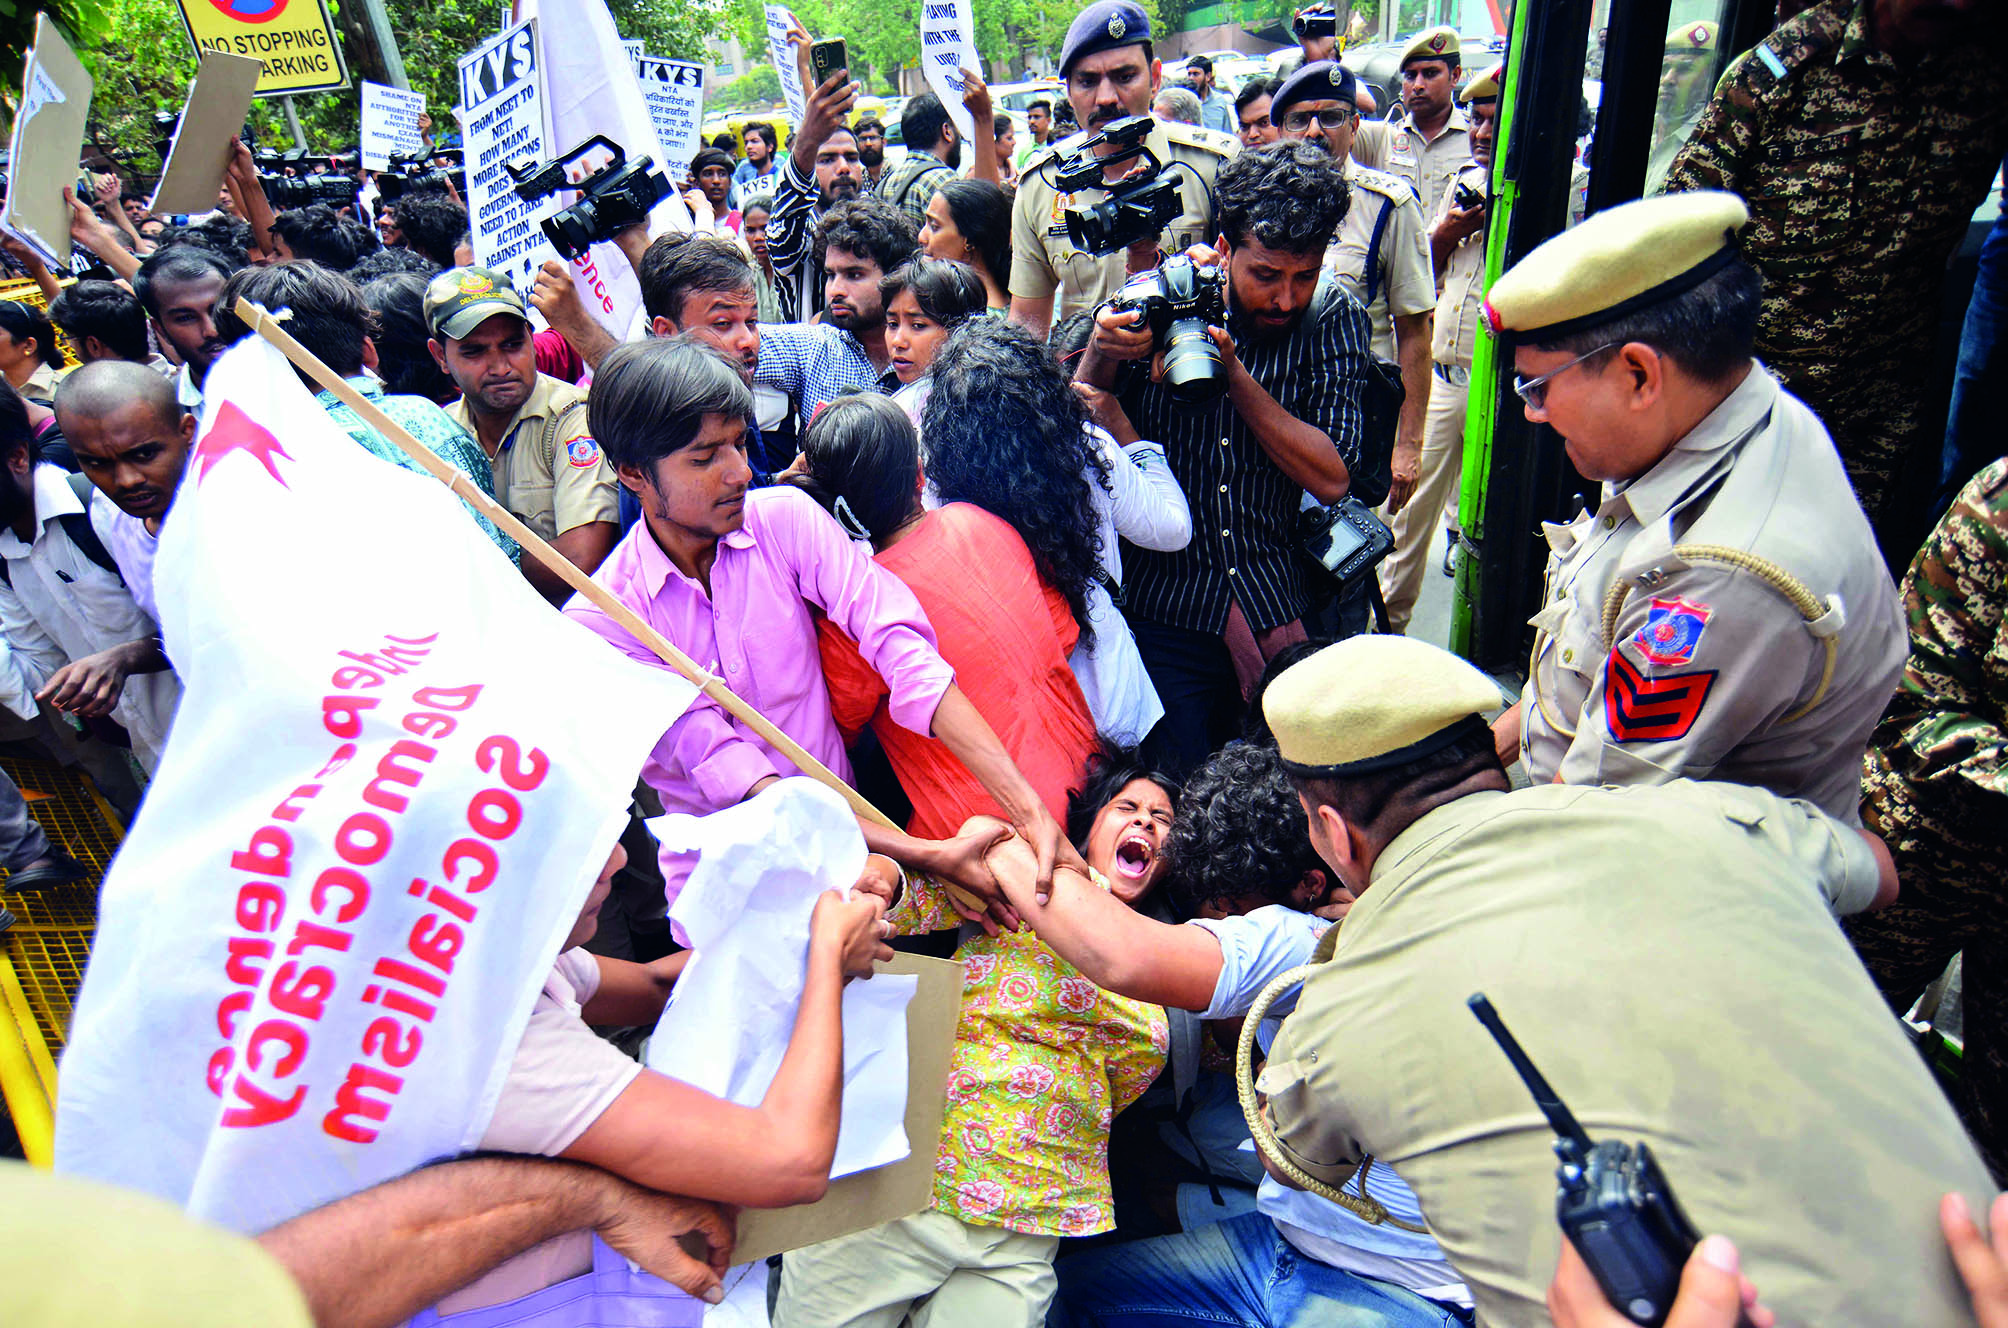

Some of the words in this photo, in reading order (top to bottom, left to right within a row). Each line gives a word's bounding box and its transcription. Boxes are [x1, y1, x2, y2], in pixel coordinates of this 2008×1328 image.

[234, 28, 326, 54] STOPPING
[262, 54, 329, 77] ARKING
[625, 46, 640, 62] YS
[465, 30, 532, 109] KYS
[644, 61, 697, 87] KYS
[380, 90, 409, 102] SHAME
[662, 85, 678, 94] NTA
[370, 102, 419, 118] AUTHORITIE
[405, 103, 422, 111] NTA
[469, 111, 494, 137] FROM
[495, 93, 519, 121] NEET
[521, 84, 534, 103] TO
[407, 117, 419, 126] YE
[491, 116, 513, 141] NET!
[398, 129, 421, 139] EXAM
[479, 142, 501, 167] HOW
[502, 124, 530, 153] MANY
[473, 162, 499, 189] MORE
[487, 174, 510, 198] DOES
[743, 177, 768, 196] KYS
[479, 214, 504, 237] NEED
[505, 207, 517, 224] TO
[496, 218, 530, 247] ACTION
[486, 240, 523, 270] AGAINST
[1173, 301, 1196, 310] Nikon
